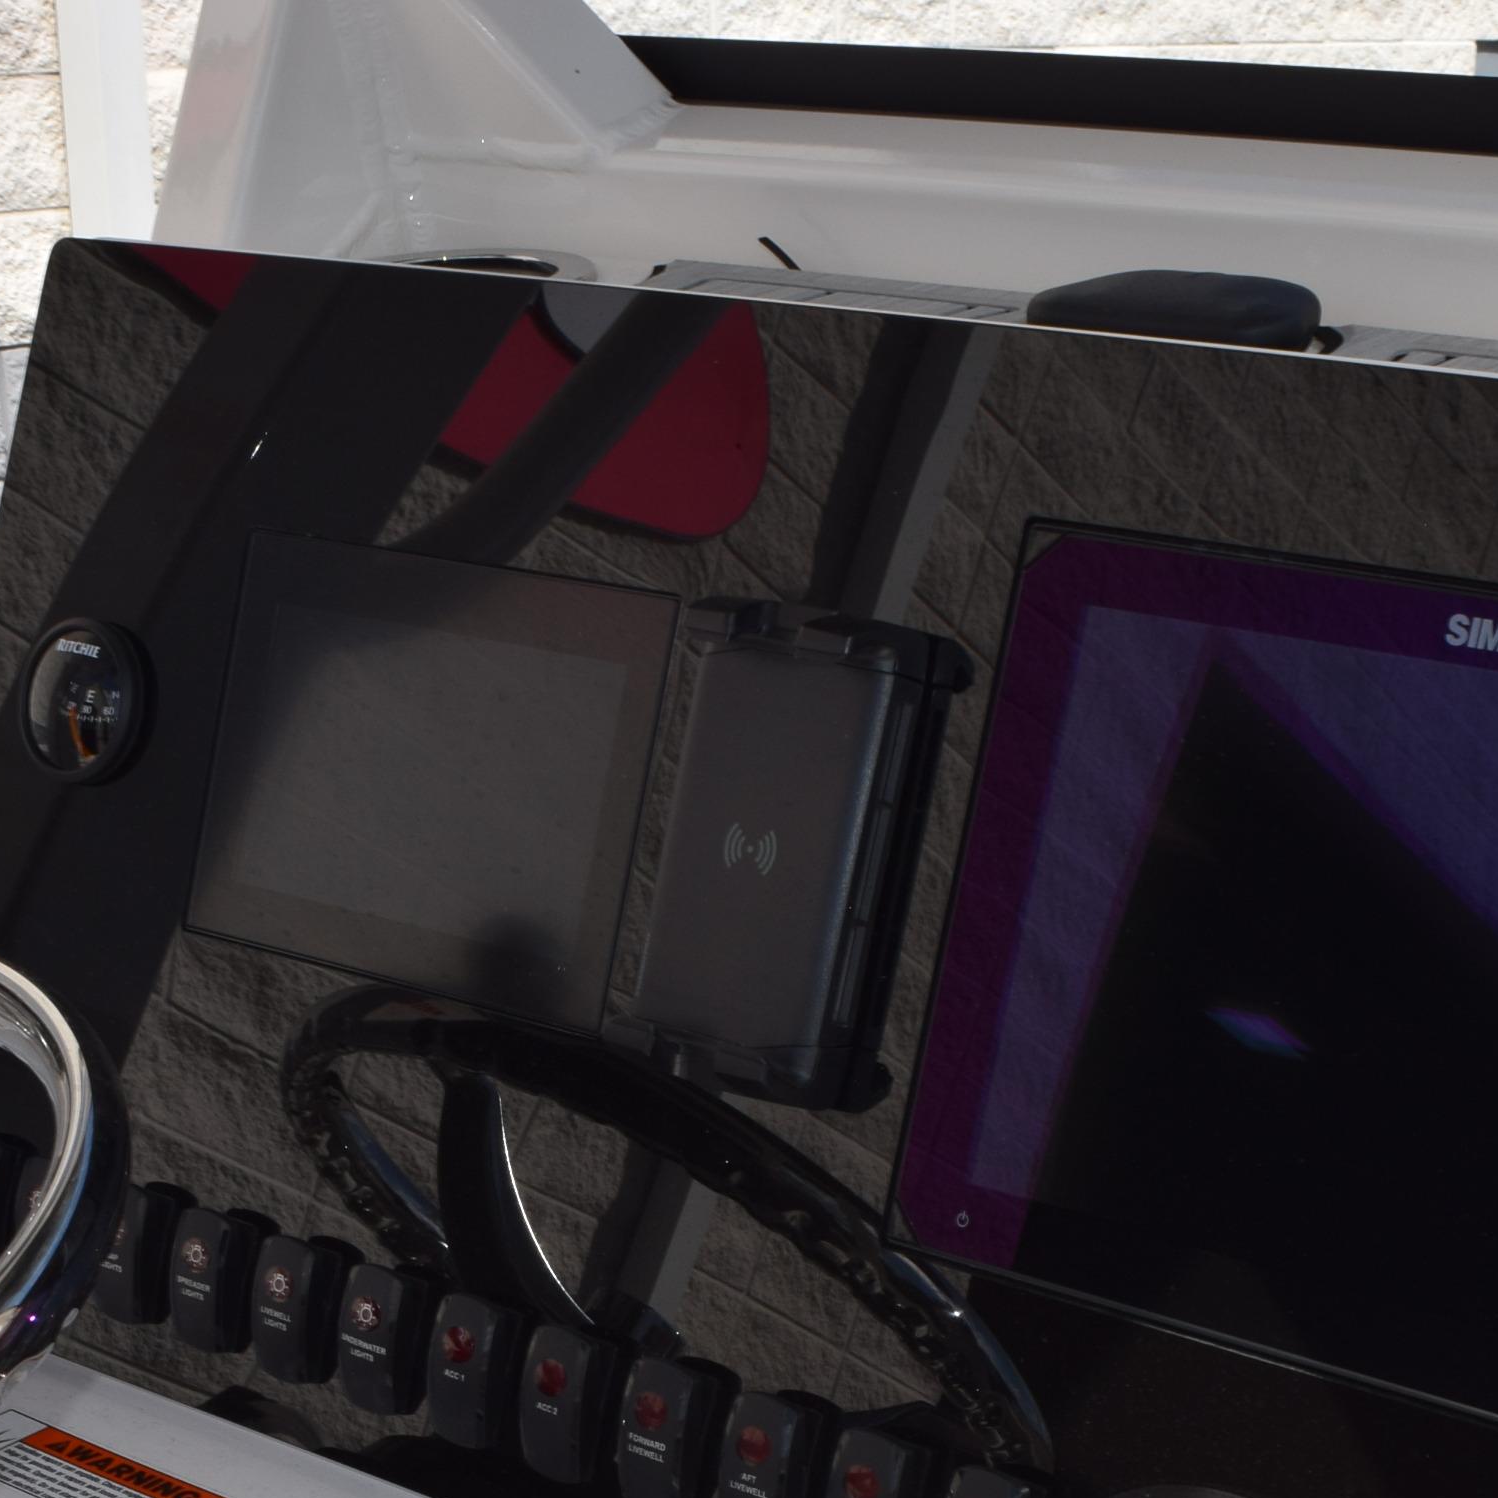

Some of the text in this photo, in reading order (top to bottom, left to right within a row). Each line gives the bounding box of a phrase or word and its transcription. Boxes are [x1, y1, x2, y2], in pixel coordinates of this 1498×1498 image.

[57, 638, 101, 659] RITCHIE
[85, 689, 97, 704] E
[177, 1275, 211, 1292] SPREADER
[182, 1288, 205, 1301] LIGHTS
[260, 1305, 292, 1323] LIVEWELL
[264, 1317, 288, 1332] LIGHTS
[341, 1332, 387, 1356] UNDERWATER
[350, 1347, 374, 1362] LIGHTS
[443, 1368, 460, 1381] ACC
[536, 1402, 552, 1414] ACC
[628, 1431, 667, 1452] FORWARD
[628, 1444, 665, 1464] LIVEWELL
[740, 1472, 757, 1485] AFT
